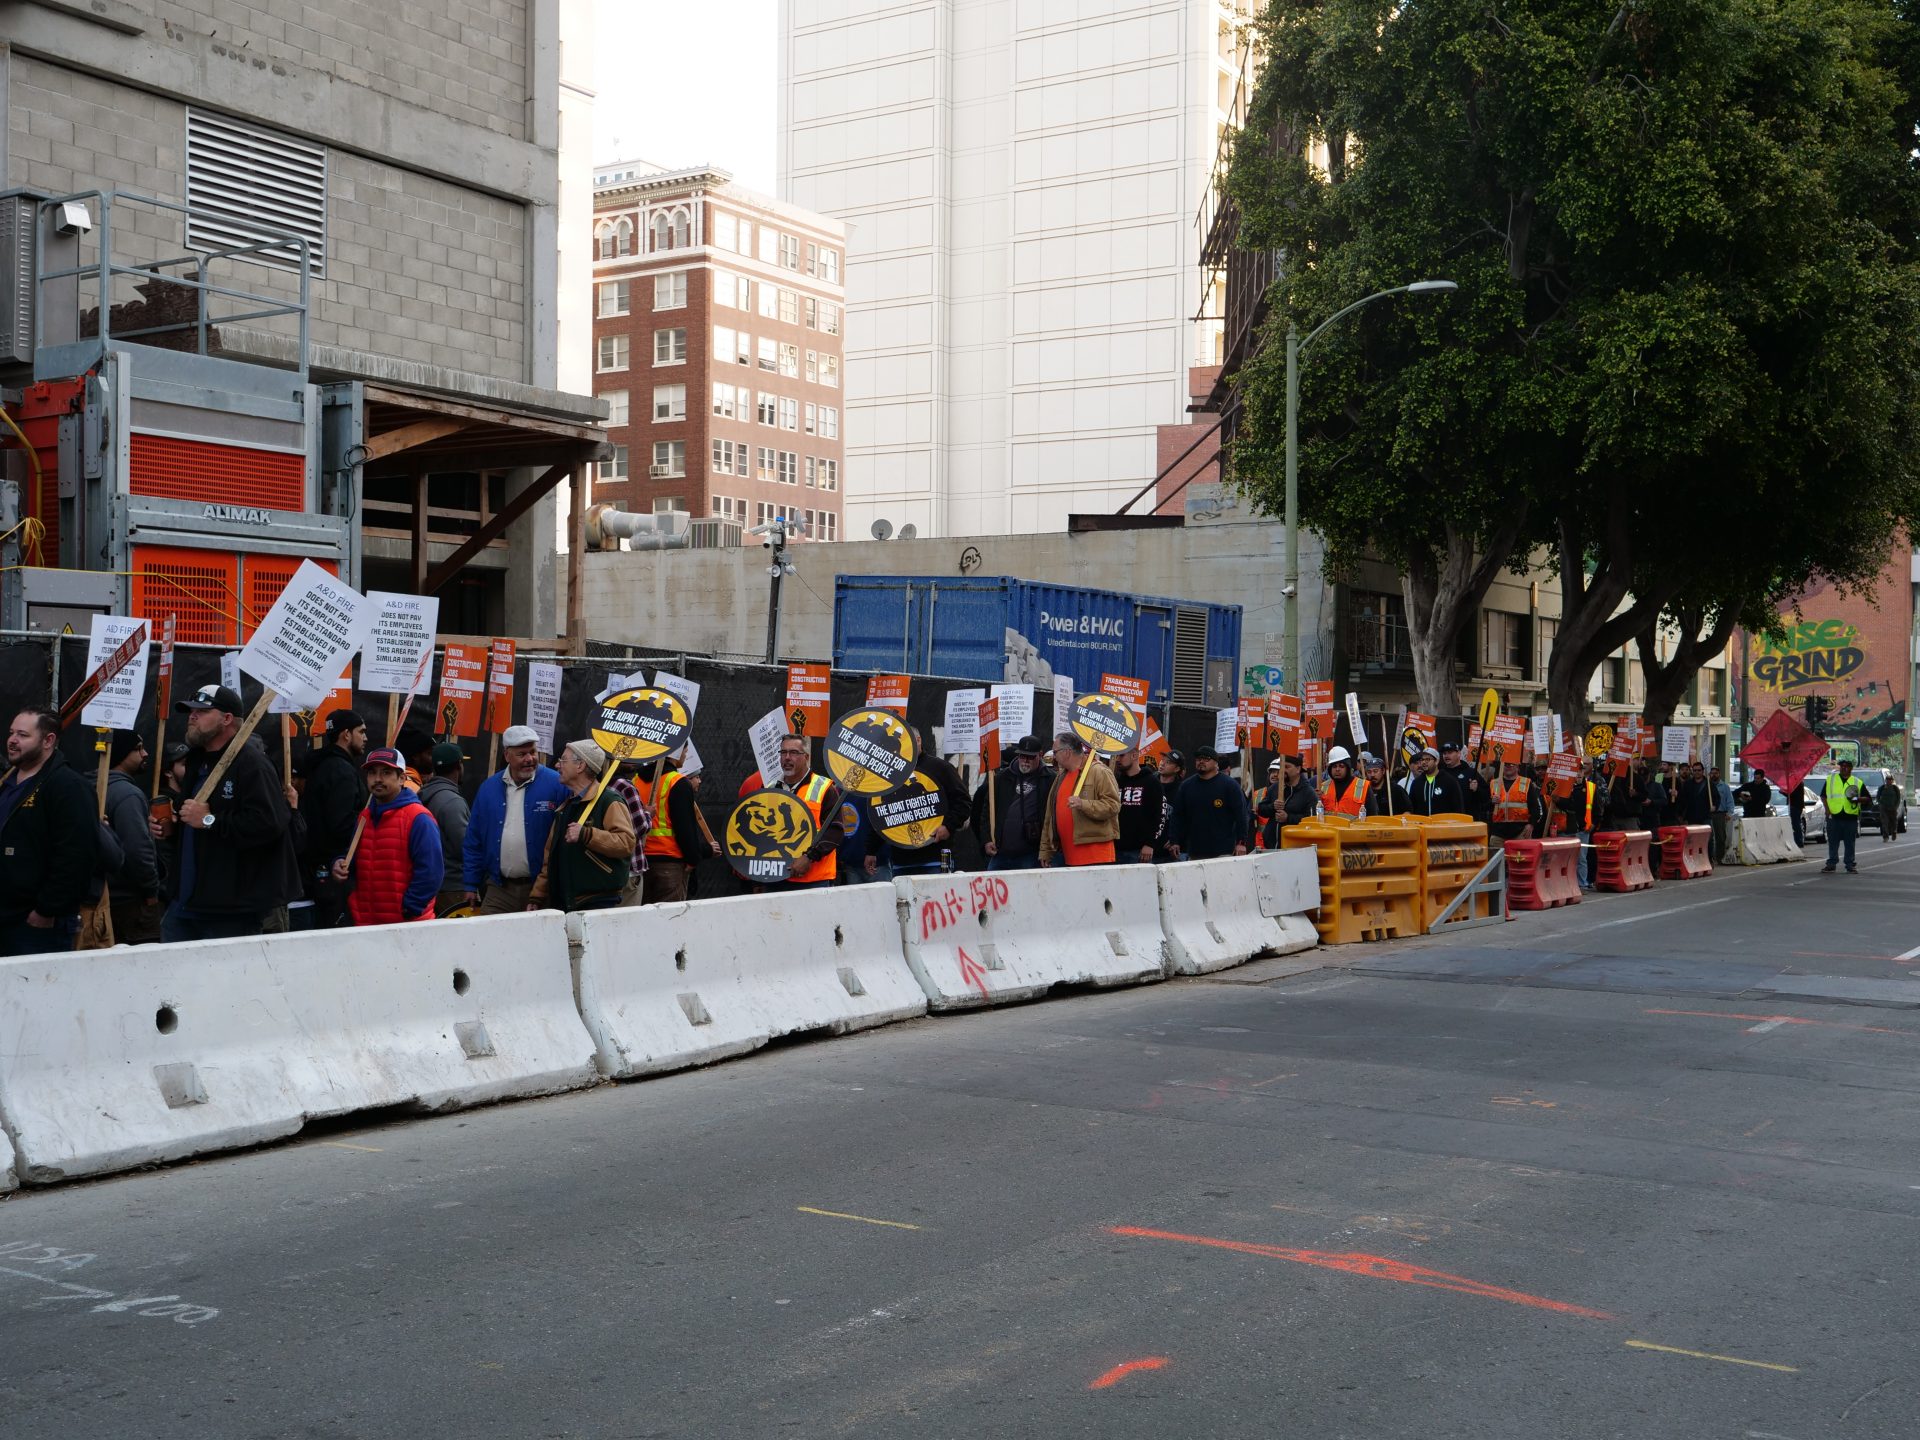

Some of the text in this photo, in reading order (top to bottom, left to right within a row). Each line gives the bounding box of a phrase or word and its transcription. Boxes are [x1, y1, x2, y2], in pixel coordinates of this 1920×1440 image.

[203, 505, 271, 524] ALIMAK
[306, 591, 352, 625] DOES NOT PAY
[316, 584, 356, 613] A&D FIRE
[405, 602, 419, 610] FIRE
[284, 603, 351, 651] THE AREA STANDARD
[298, 598, 348, 635] ITS EMPLOYEES
[390, 622, 423, 630] EMPLOYEES
[1040, 612, 1123, 637] Power & HVAC
[280, 627, 328, 662] THIS AREA FOR
[284, 617, 337, 654] ESTABLISHED IN
[377, 638, 414, 646] ESTABLISHED
[400, 630, 429, 639] STANDARD
[272, 637, 323, 672] SIMILAR WORK
[376, 655, 400, 663] SIMILAR
[391, 647, 406, 655] AREA
[448, 648, 463, 658] UNION
[446, 669, 458, 677] JOBS
[447, 658, 481, 670] CONSTRUCTION
[1754, 647, 1864, 690] GRIND
[1105, 677, 1140, 688] TRABAJOS DE
[1268, 670, 1279, 683] P
[443, 689, 472, 699] OAKLANDERS
[1104, 684, 1144, 697] CONSTRUCCIÓN
[601, 708, 682, 736] THE IUPAT FIGHTS FOR
[602, 720, 668, 744] WORKING PEOPLE
[1076, 706, 1134, 737] THE IUPAT FIGHTS FOR
[1079, 715, 1126, 743] WORKING PEOPLE
[838, 727, 907, 772] THE IUPAT FIGHTS FOR
[838, 742, 895, 779] WORKING PEOPLE
[875, 793, 941, 817] THE IUPAT FIGHTS FOR
[884, 805, 937, 827] WORKING PEOPLE
[748, 860, 786, 876] IUPAT
